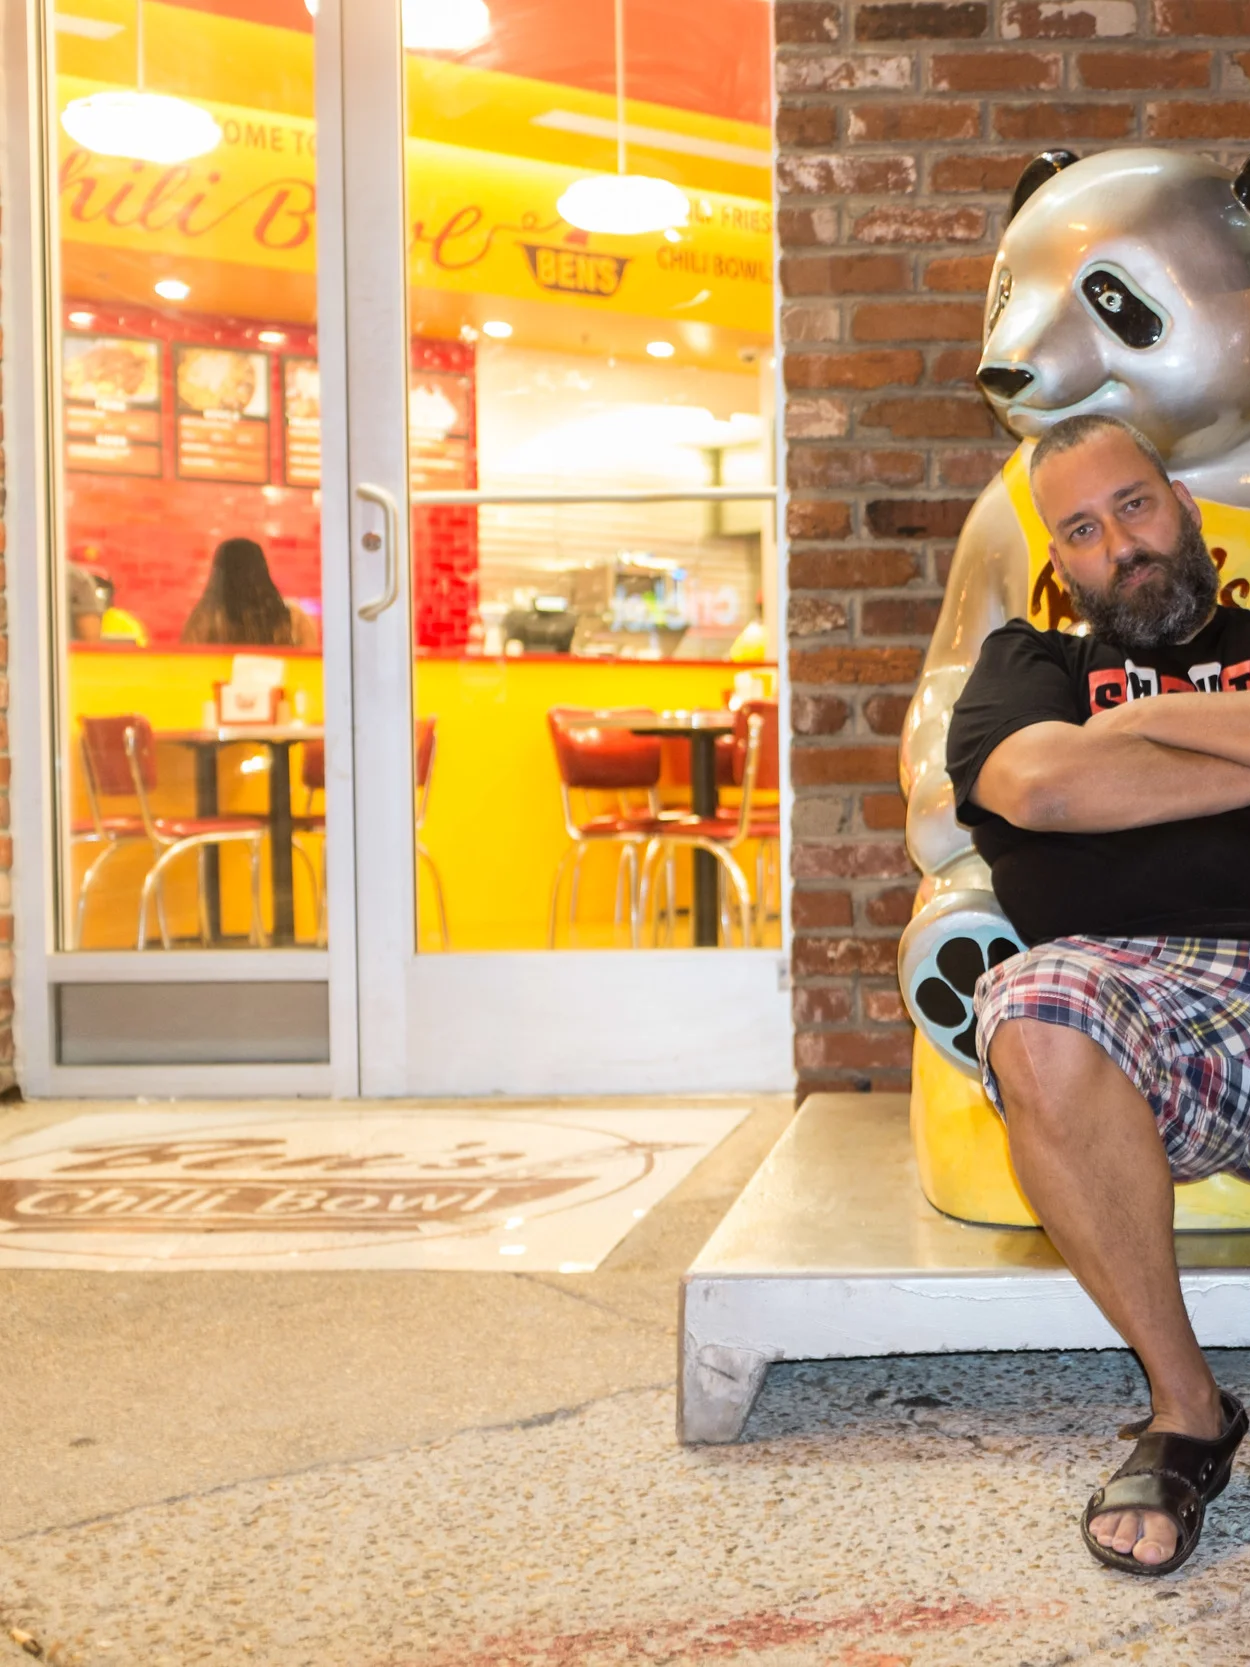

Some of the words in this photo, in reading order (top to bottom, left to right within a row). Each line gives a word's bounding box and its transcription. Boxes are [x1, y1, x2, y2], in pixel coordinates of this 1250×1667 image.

[57, 148, 228, 239] hili
[656, 245, 708, 274] CHILI
[713, 254, 772, 284] BOWL
[14, 1187, 240, 1215] Chili
[254, 1187, 500, 1214] Bowl
